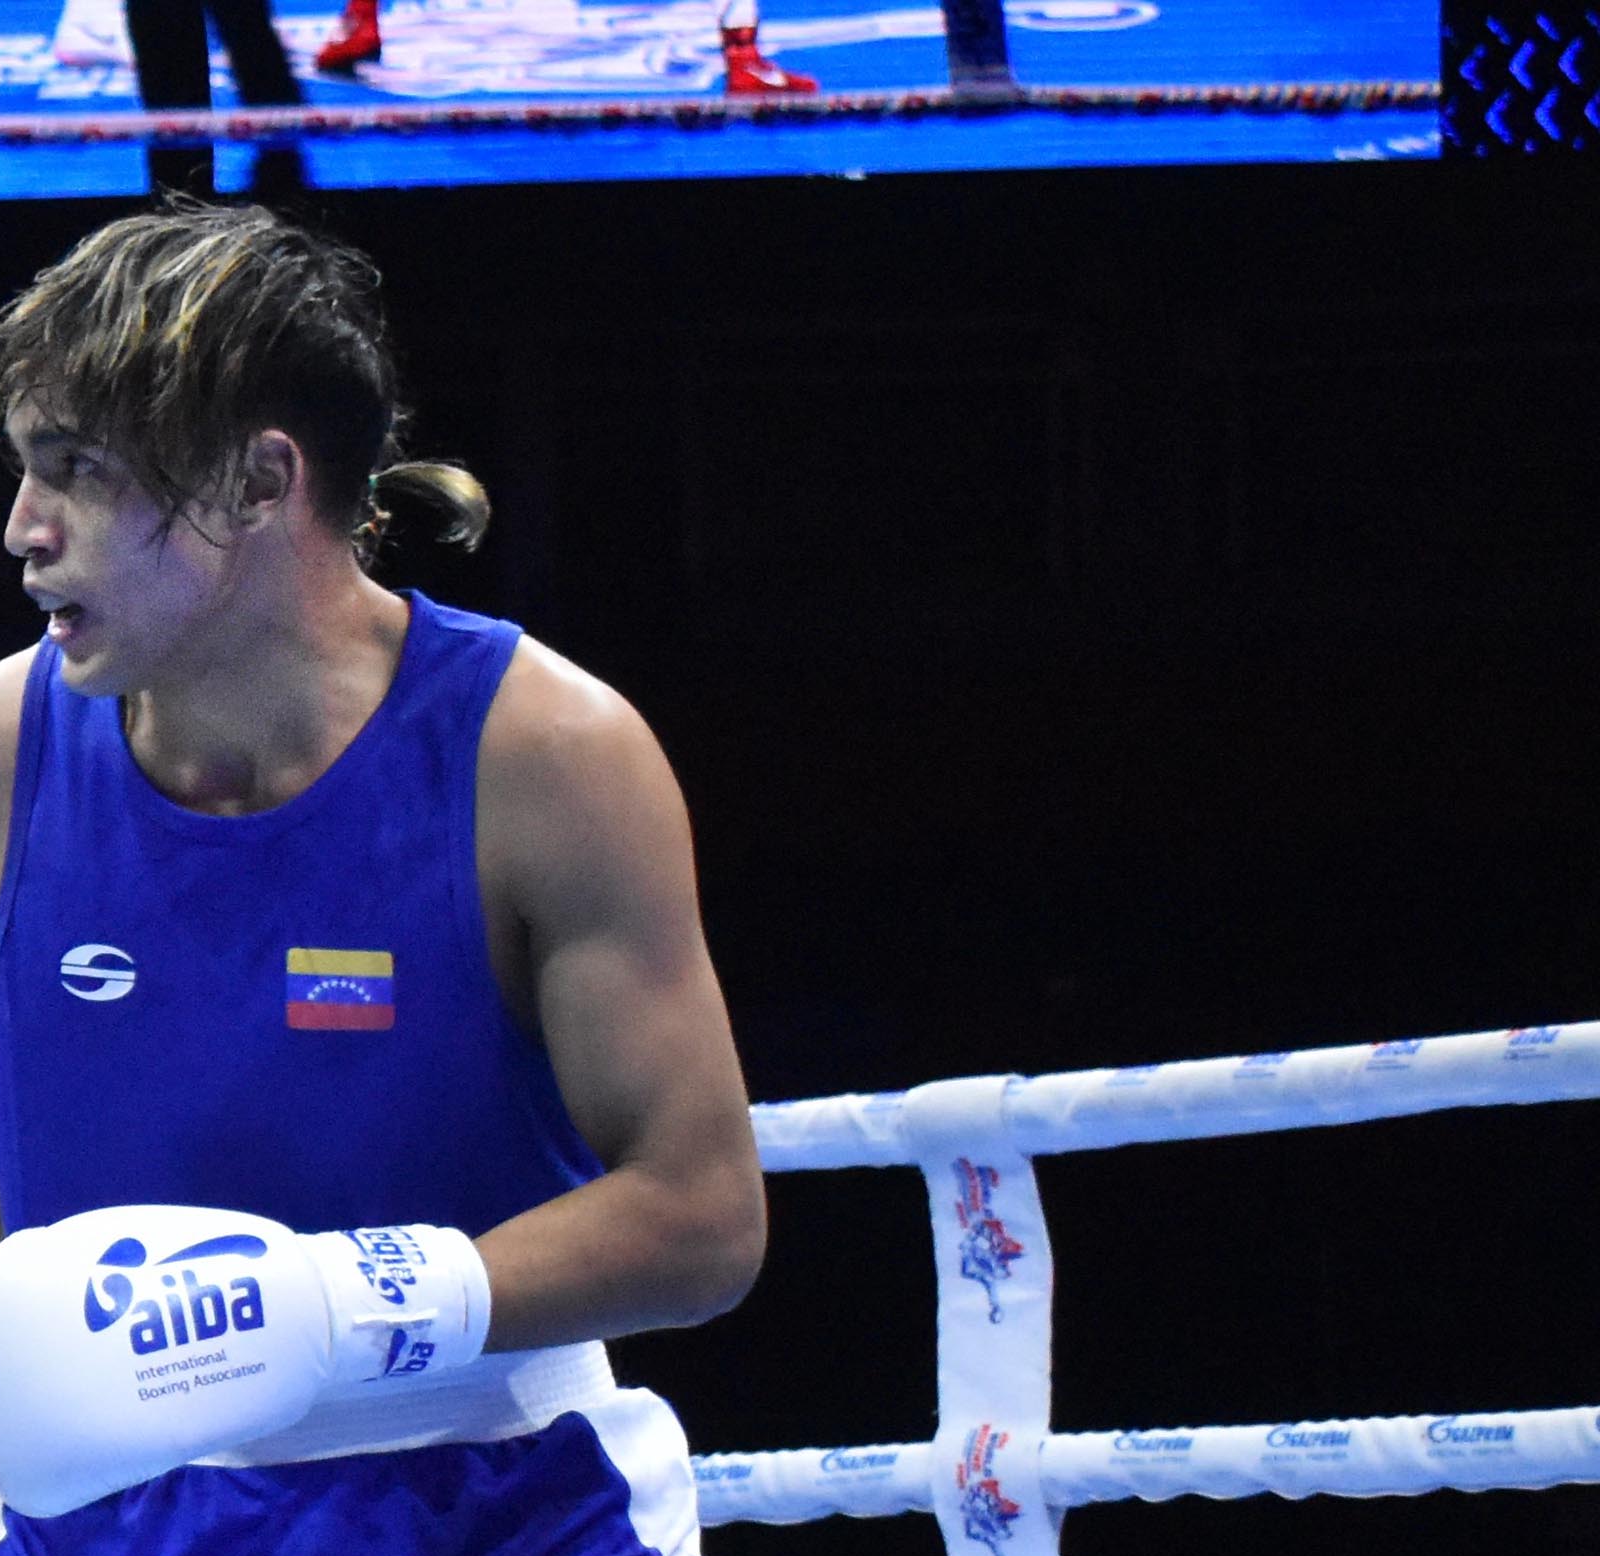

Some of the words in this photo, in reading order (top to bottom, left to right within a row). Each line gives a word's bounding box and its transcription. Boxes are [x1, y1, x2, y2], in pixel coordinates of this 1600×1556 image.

[129, 1267, 265, 1355] aiba
[135, 1349, 228, 1382] International
[137, 1379, 190, 1402] Boxing
[194, 1361, 267, 1387] Association
